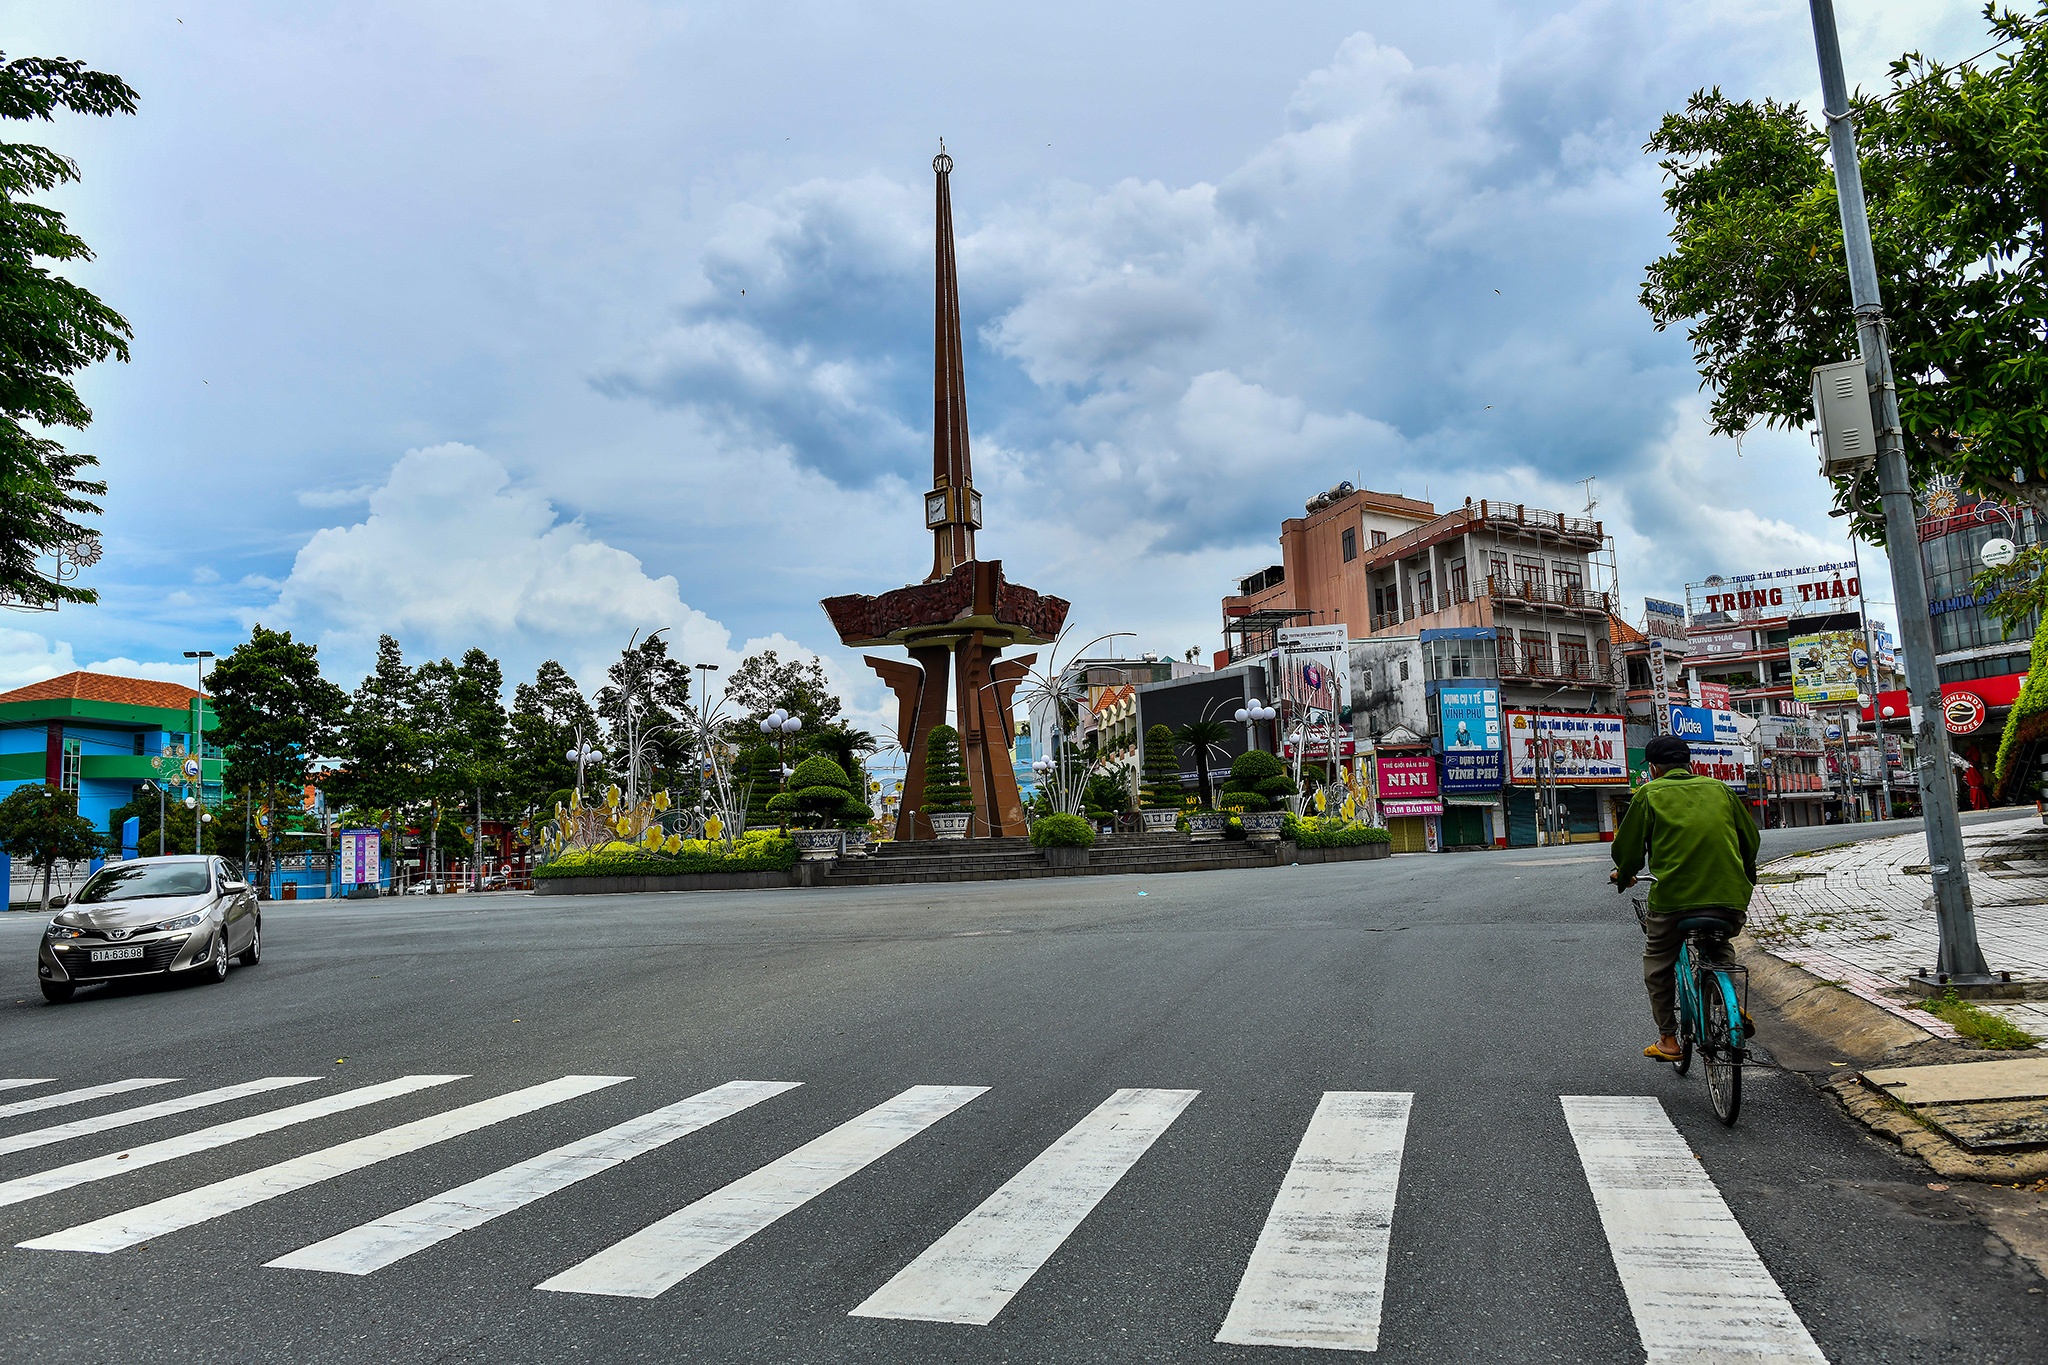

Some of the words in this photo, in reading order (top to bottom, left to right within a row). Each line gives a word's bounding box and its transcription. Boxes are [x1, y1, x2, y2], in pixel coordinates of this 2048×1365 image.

[1732, 574, 1755, 584] TRUNG
[1758, 571, 1772, 580] TÂM
[1776, 568, 1793, 579] ĐIỆN
[1796, 565, 1811, 576] MÁY
[1818, 562, 1836, 573] ĐIỆN
[1706, 587, 1783, 612] TRUNG
[1798, 572, 1860, 602] THẢO
[1929, 600, 1945, 617] ÂM
[1946, 595, 1974, 612] MUA
[1688, 636, 1712, 644] TRUNG
[1714, 633, 1733, 642] THẢO
[1444, 694, 1459, 706] DỤNG
[1460, 694, 1468, 706] CỤ
[1468, 694, 1473, 704] Y
[1473, 690, 1481, 704] TẾ
[1548, 719, 1561, 730] TÂM
[1562, 720, 1575, 732] ĐIỆN
[1576, 720, 1589, 731] MÁY
[1593, 720, 1606, 732] ĐIỆN
[1606, 723, 1620, 734] LẠNH
[1675, 712, 1702, 735] Midea
[1946, 720, 1979, 732] COFFEE
[1572, 735, 1613, 760] NGÂN
[1383, 759, 1393, 768] THẾ
[1406, 760, 1417, 768] ĐẦM
[1460, 756, 1475, 766] DỤNG
[1476, 756, 1484, 766] CỤ
[1486, 756, 1490, 764] Y
[1491, 752, 1498, 764] TẾ
[1387, 773, 1406, 786] NI
[1408, 772, 1428, 786] NI
[1448, 767, 1474, 780] VĨNH
[1476, 766, 1498, 779] PHÚ
[1186, 796, 1197, 804] XÂY
[1386, 804, 1404, 814] ĐẦM
[1406, 804, 1421, 812] BẦU
